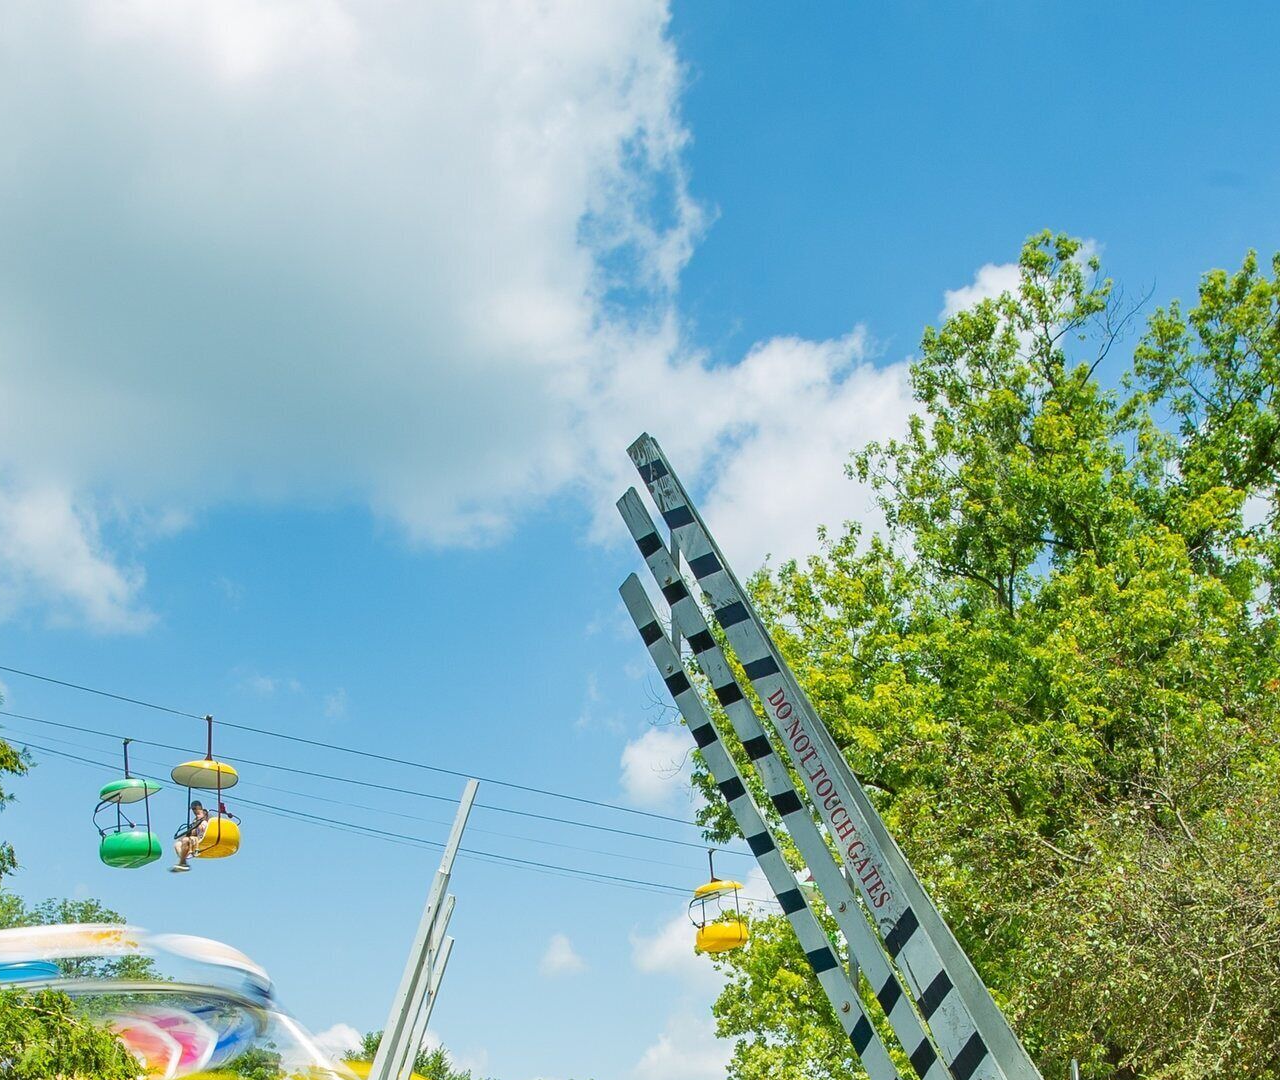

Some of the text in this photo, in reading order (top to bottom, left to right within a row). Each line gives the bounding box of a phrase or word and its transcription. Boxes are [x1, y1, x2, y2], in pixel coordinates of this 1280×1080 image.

[767, 686, 892, 908] DO NOT TOUCH GATES
